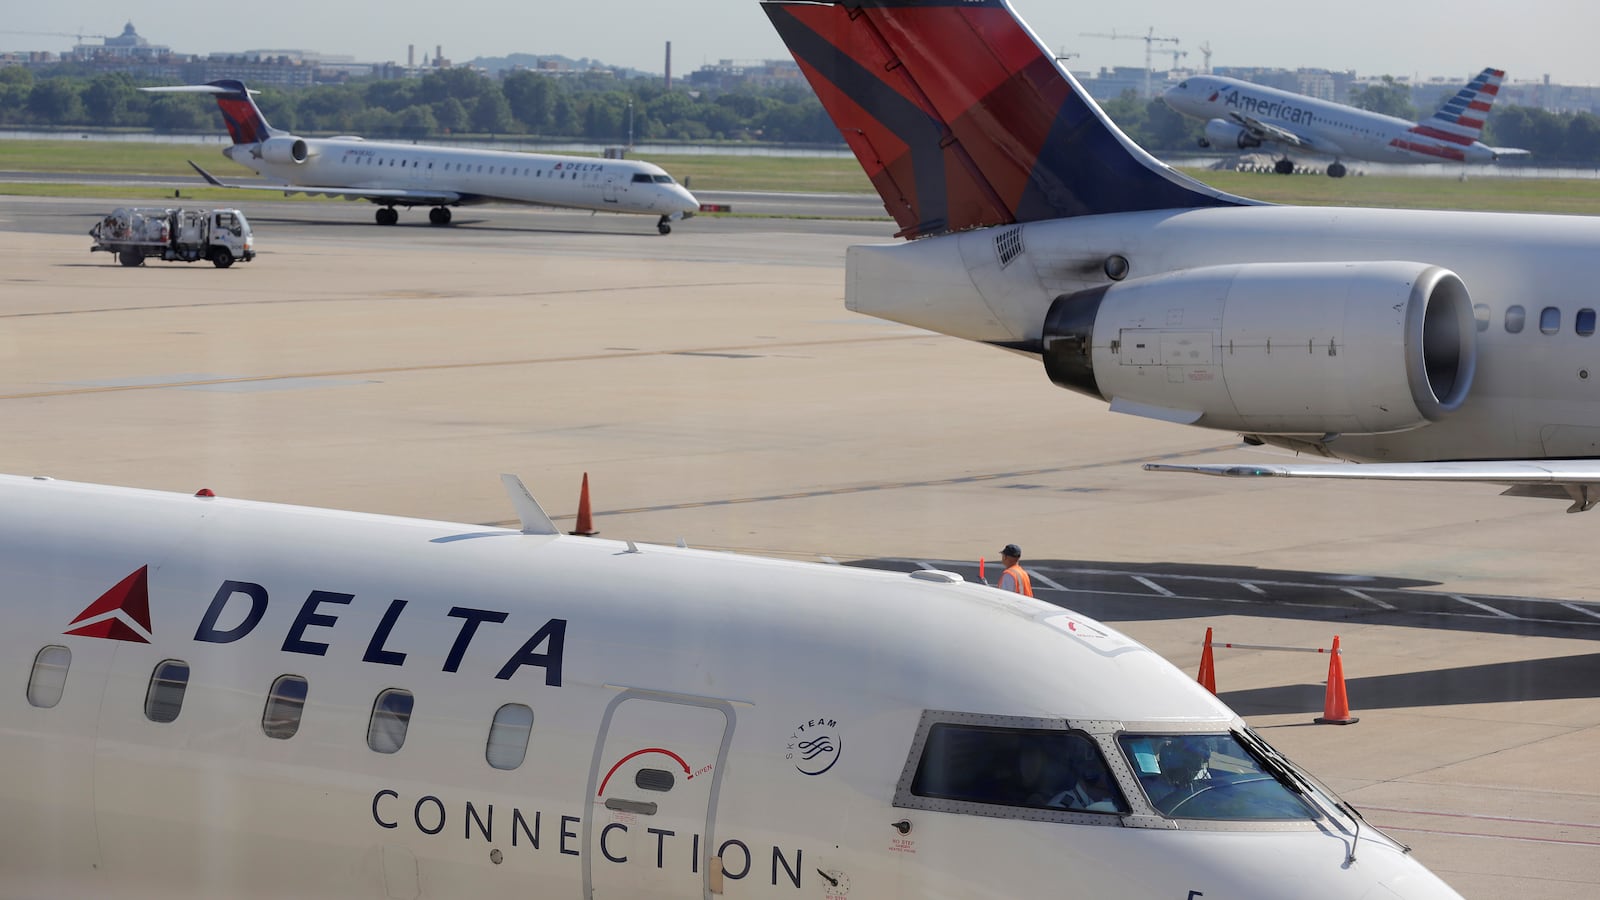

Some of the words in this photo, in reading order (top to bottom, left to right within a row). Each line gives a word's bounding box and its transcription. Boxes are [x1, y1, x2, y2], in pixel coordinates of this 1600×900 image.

[1225, 90, 1313, 126] American
[565, 162, 604, 172] DELTA
[193, 580, 567, 688] DELTA
[785, 718, 837, 760] SKYTEAM
[694, 763, 713, 776] OPEN
[372, 789, 803, 889] CONNECTION
